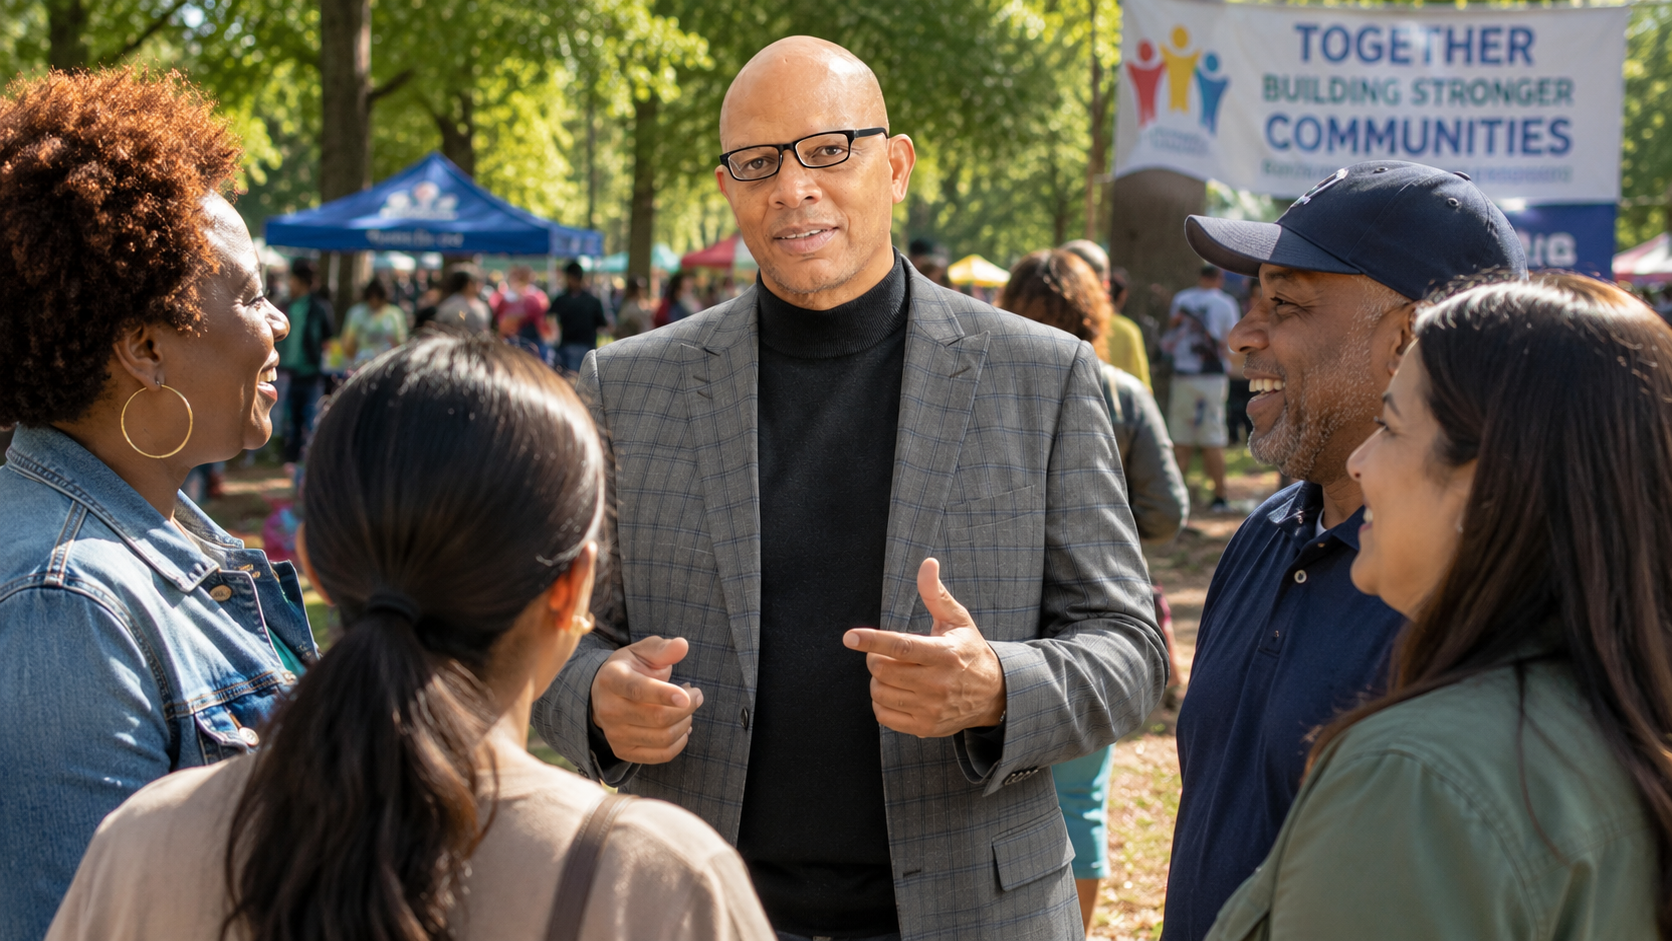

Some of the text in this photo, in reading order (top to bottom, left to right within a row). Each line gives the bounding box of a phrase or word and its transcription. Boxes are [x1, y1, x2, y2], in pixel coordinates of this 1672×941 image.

[1295, 24, 1535, 65] TOGETHER
[1263, 74, 1574, 107] BUILDING STRONGER
[1265, 113, 1573, 156] COMMUNITIES
